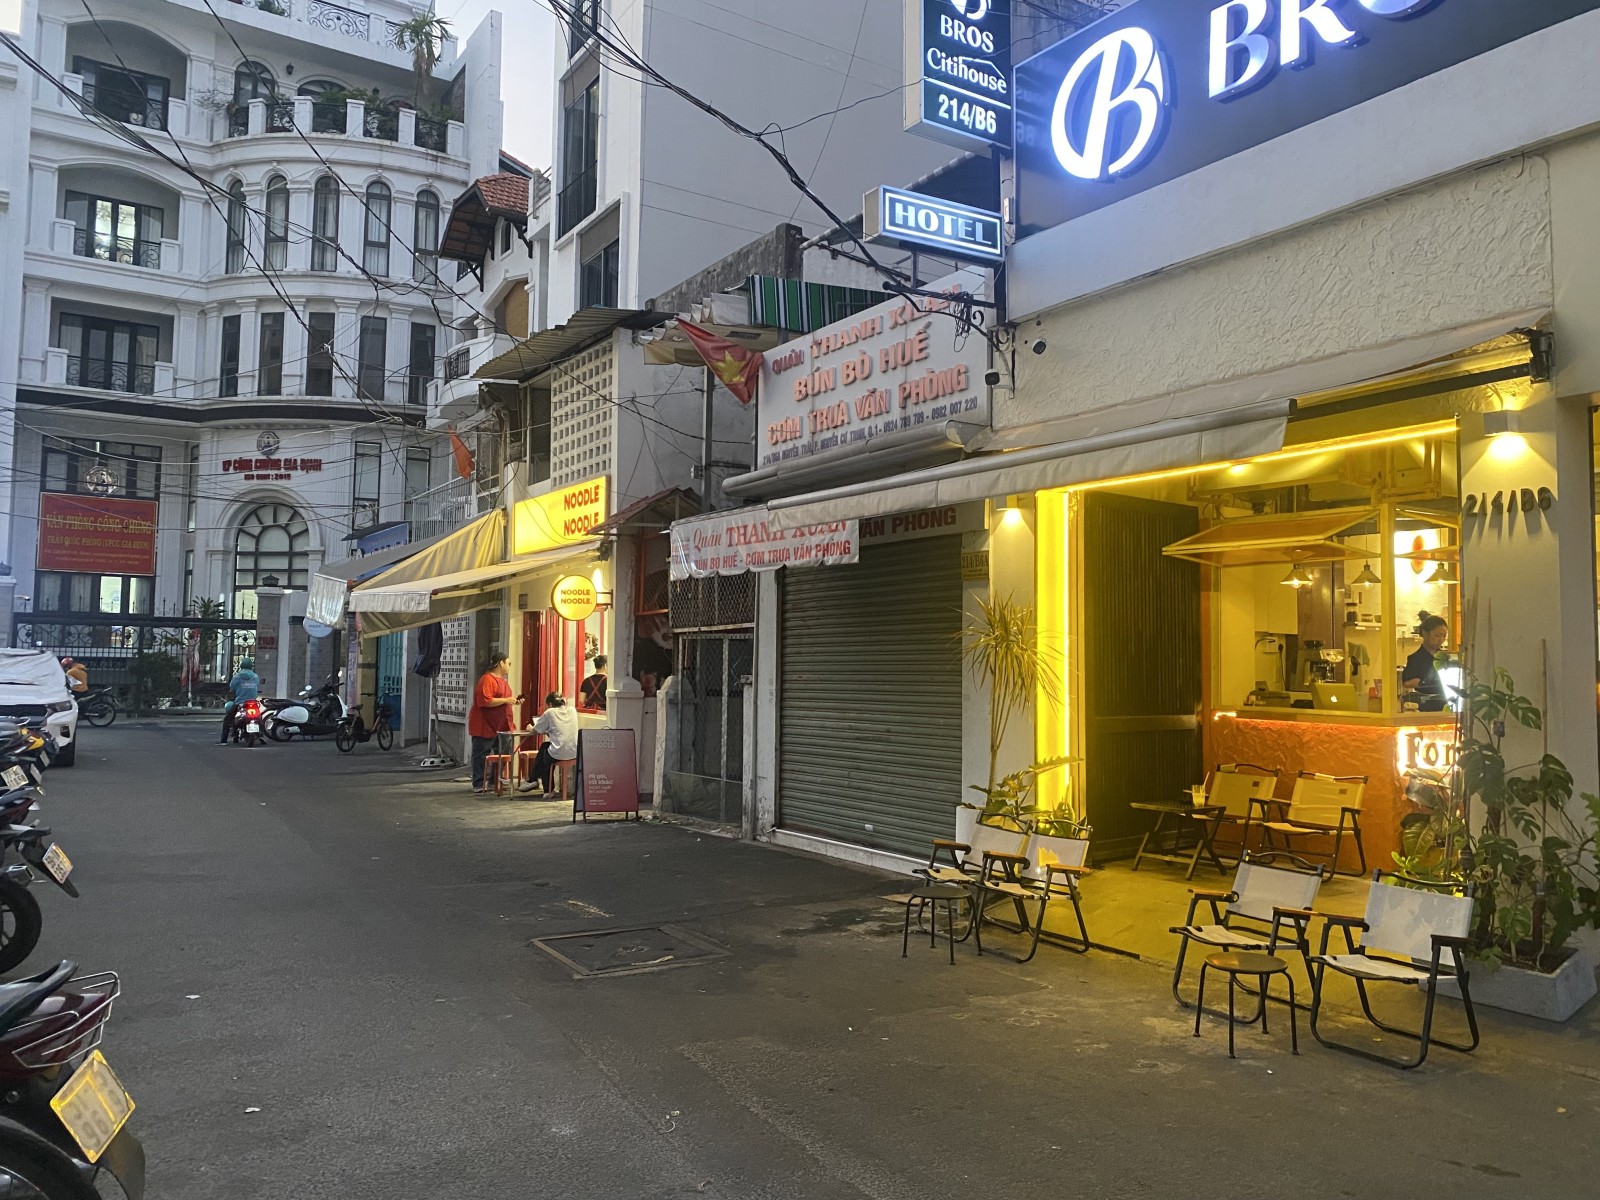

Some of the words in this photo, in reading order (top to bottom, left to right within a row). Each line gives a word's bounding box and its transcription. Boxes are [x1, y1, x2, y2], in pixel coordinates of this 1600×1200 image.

[940, 14, 994, 53] BROS
[927, 47, 1007, 93] Citihouse
[938, 94, 997, 134] 214/B6
[895, 202, 992, 245] HOTEL
[810, 316, 884, 359] THANH
[794, 366, 836, 402] BÚN
[841, 350, 872, 386] BÒ
[879, 321, 932, 374] HUẾ
[855, 388, 890, 421] VĂN
[898, 363, 968, 409] PHÒNG
[564, 485, 600, 511] NOODLE
[694, 528, 722, 552] Quán
[722, 550, 739, 568] HUẾ
[768, 547, 790, 564] TRƯA
[794, 543, 812, 561] VĂN
[815, 538, 851, 559] PHÒNG
